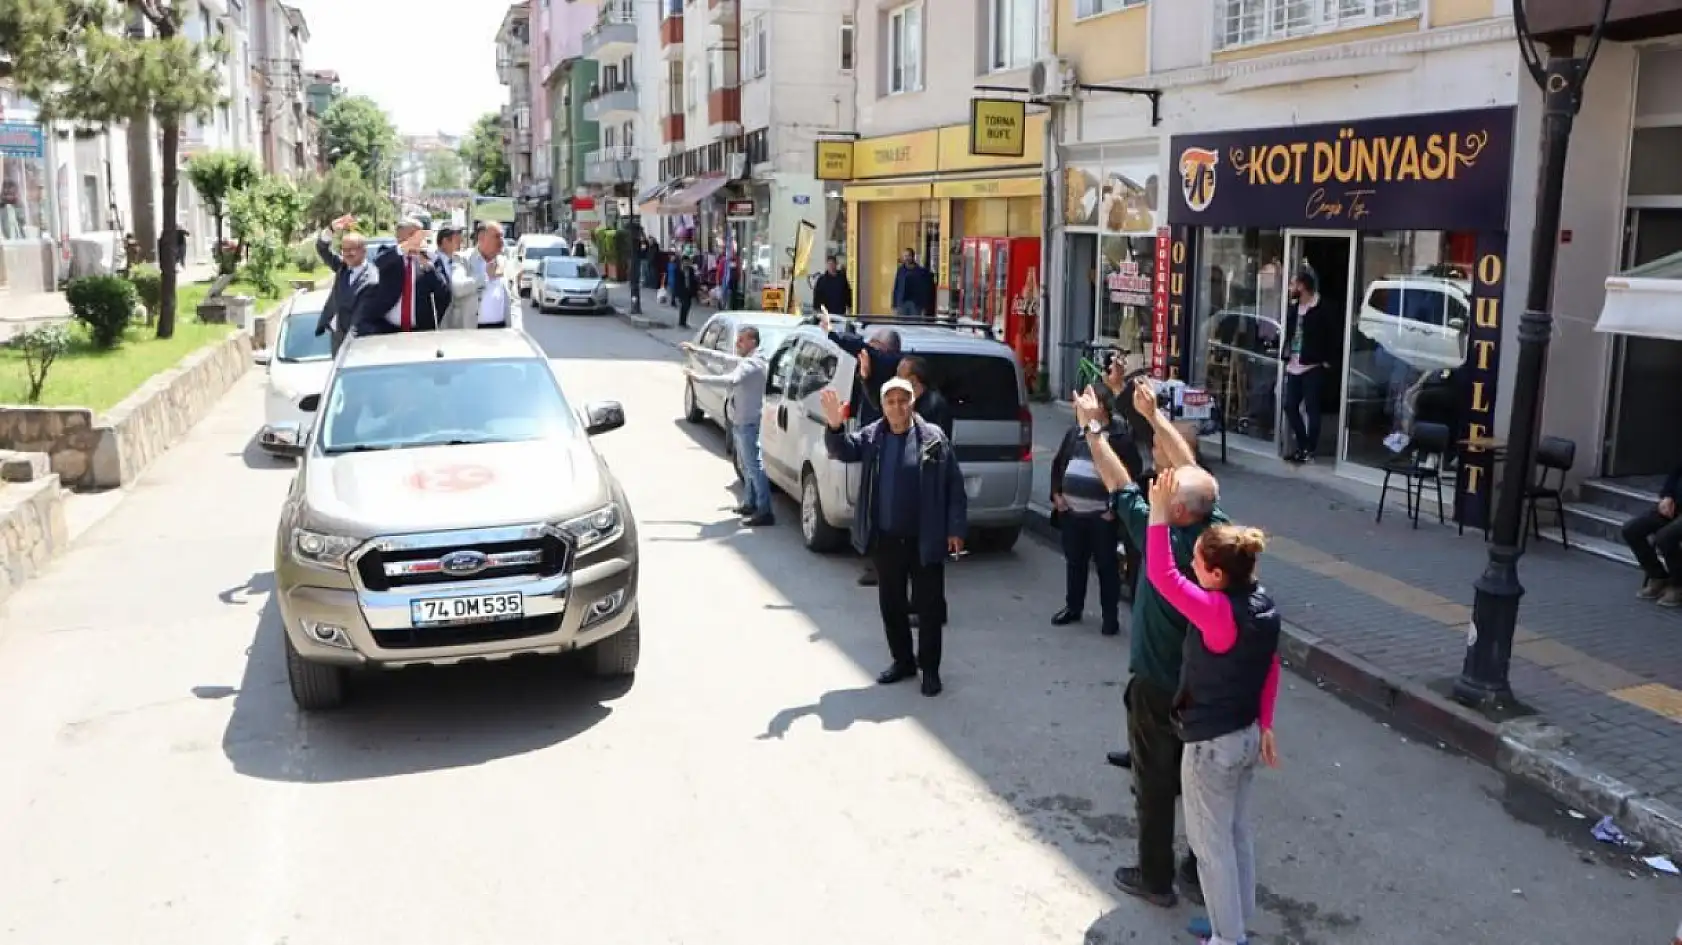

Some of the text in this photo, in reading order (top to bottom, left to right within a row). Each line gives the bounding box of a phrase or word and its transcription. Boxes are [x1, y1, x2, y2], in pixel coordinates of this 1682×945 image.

[984, 115, 1016, 127] TORNA
[1250, 143, 1308, 185] KOT
[1313, 128, 1457, 183] DÜNYASI
[1170, 241, 1185, 380] OUTLE
[1464, 254, 1502, 494] OUTLET
[425, 602, 449, 620] 74
[453, 600, 479, 617] DM
[484, 595, 519, 614] 535
